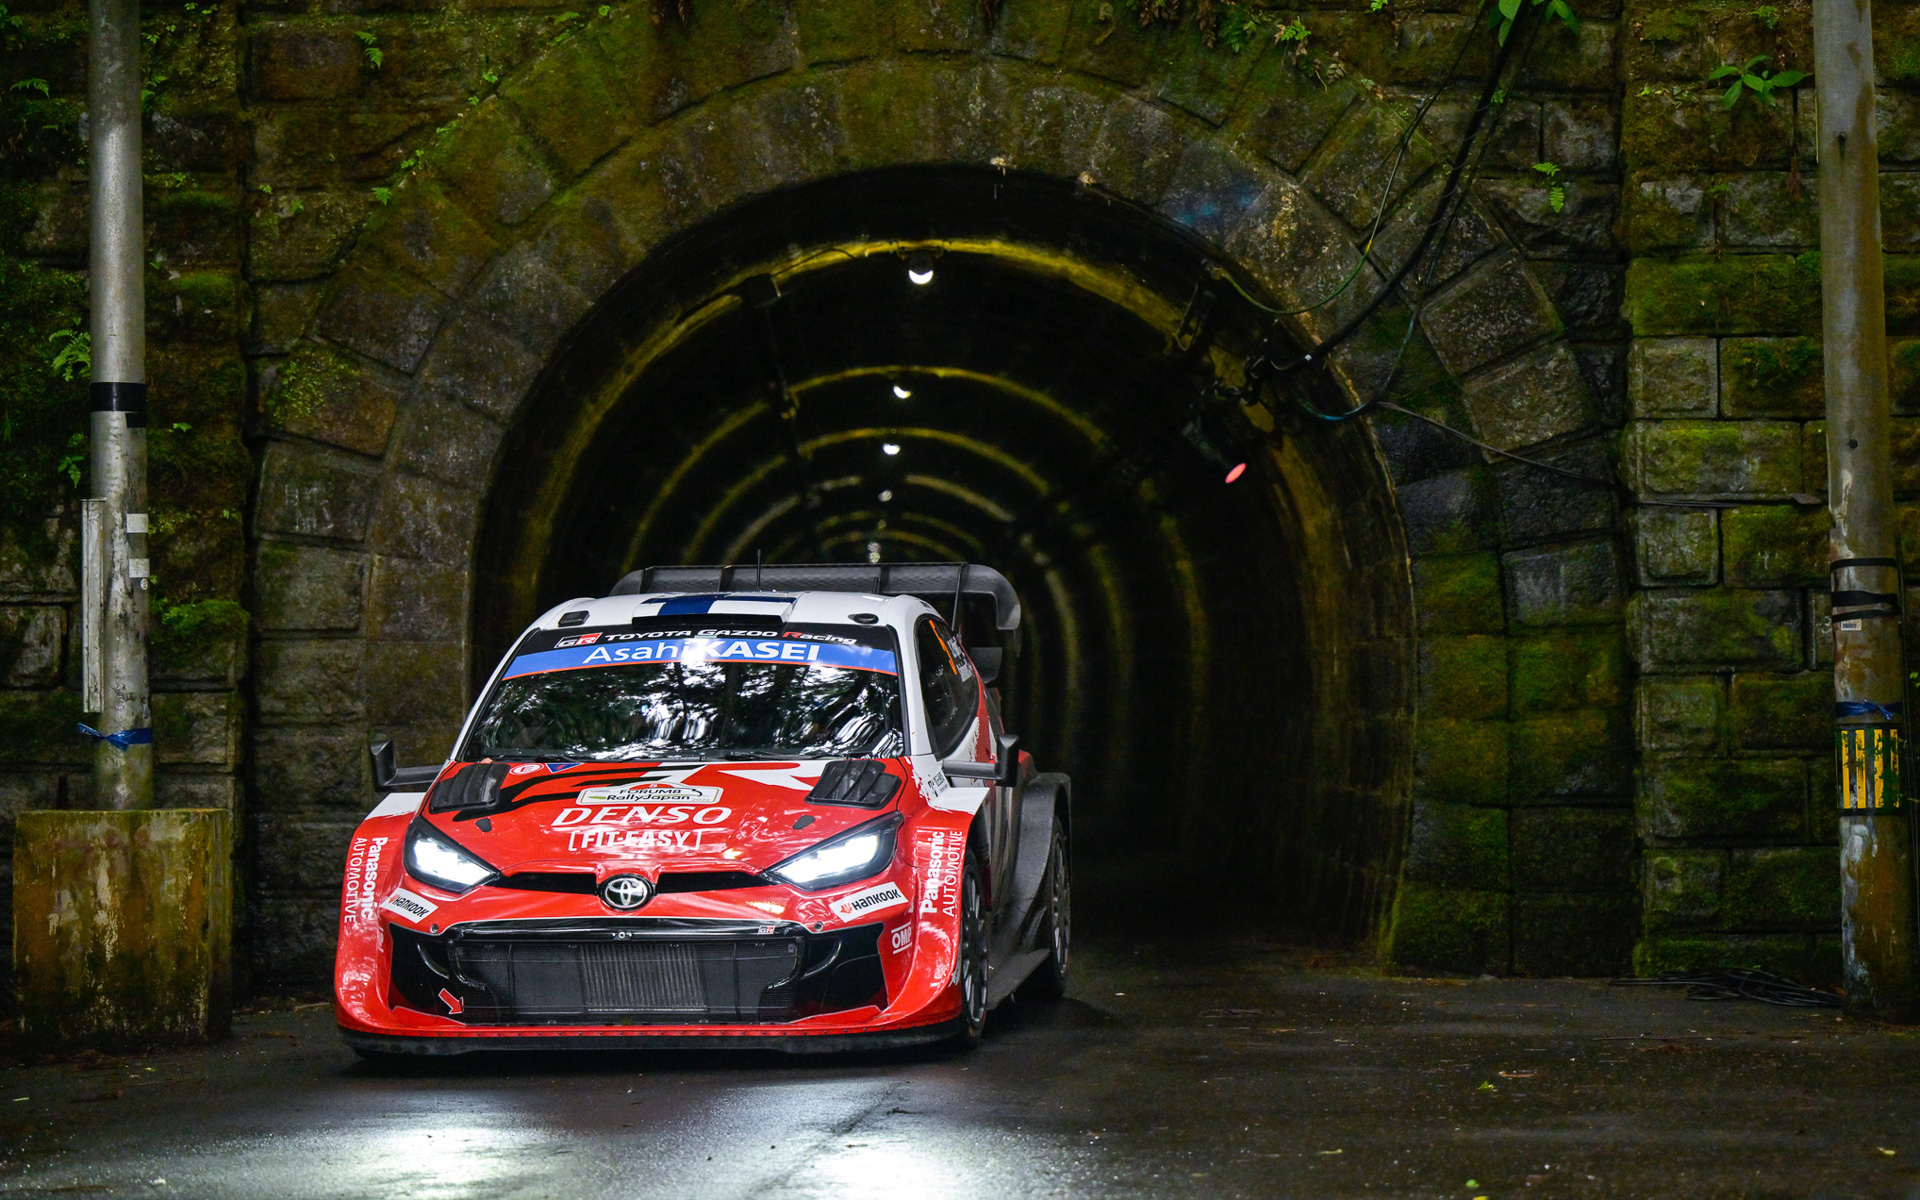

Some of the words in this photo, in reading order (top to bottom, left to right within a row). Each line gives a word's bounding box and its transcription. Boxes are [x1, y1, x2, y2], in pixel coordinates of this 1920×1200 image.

[557, 635, 597, 647] GR
[605, 630, 692, 642] TOYOTA
[697, 628, 778, 637] GAZOO
[782, 631, 858, 646] Racing
[551, 806, 732, 827] DENSO
[344, 837, 368, 924] AUTOMOTIVE
[361, 836, 389, 920] Panasonic
[920, 831, 946, 914] Panasonic
[942, 830, 963, 918] AUTOMOTIVE
[891, 926, 912, 949] OMP
